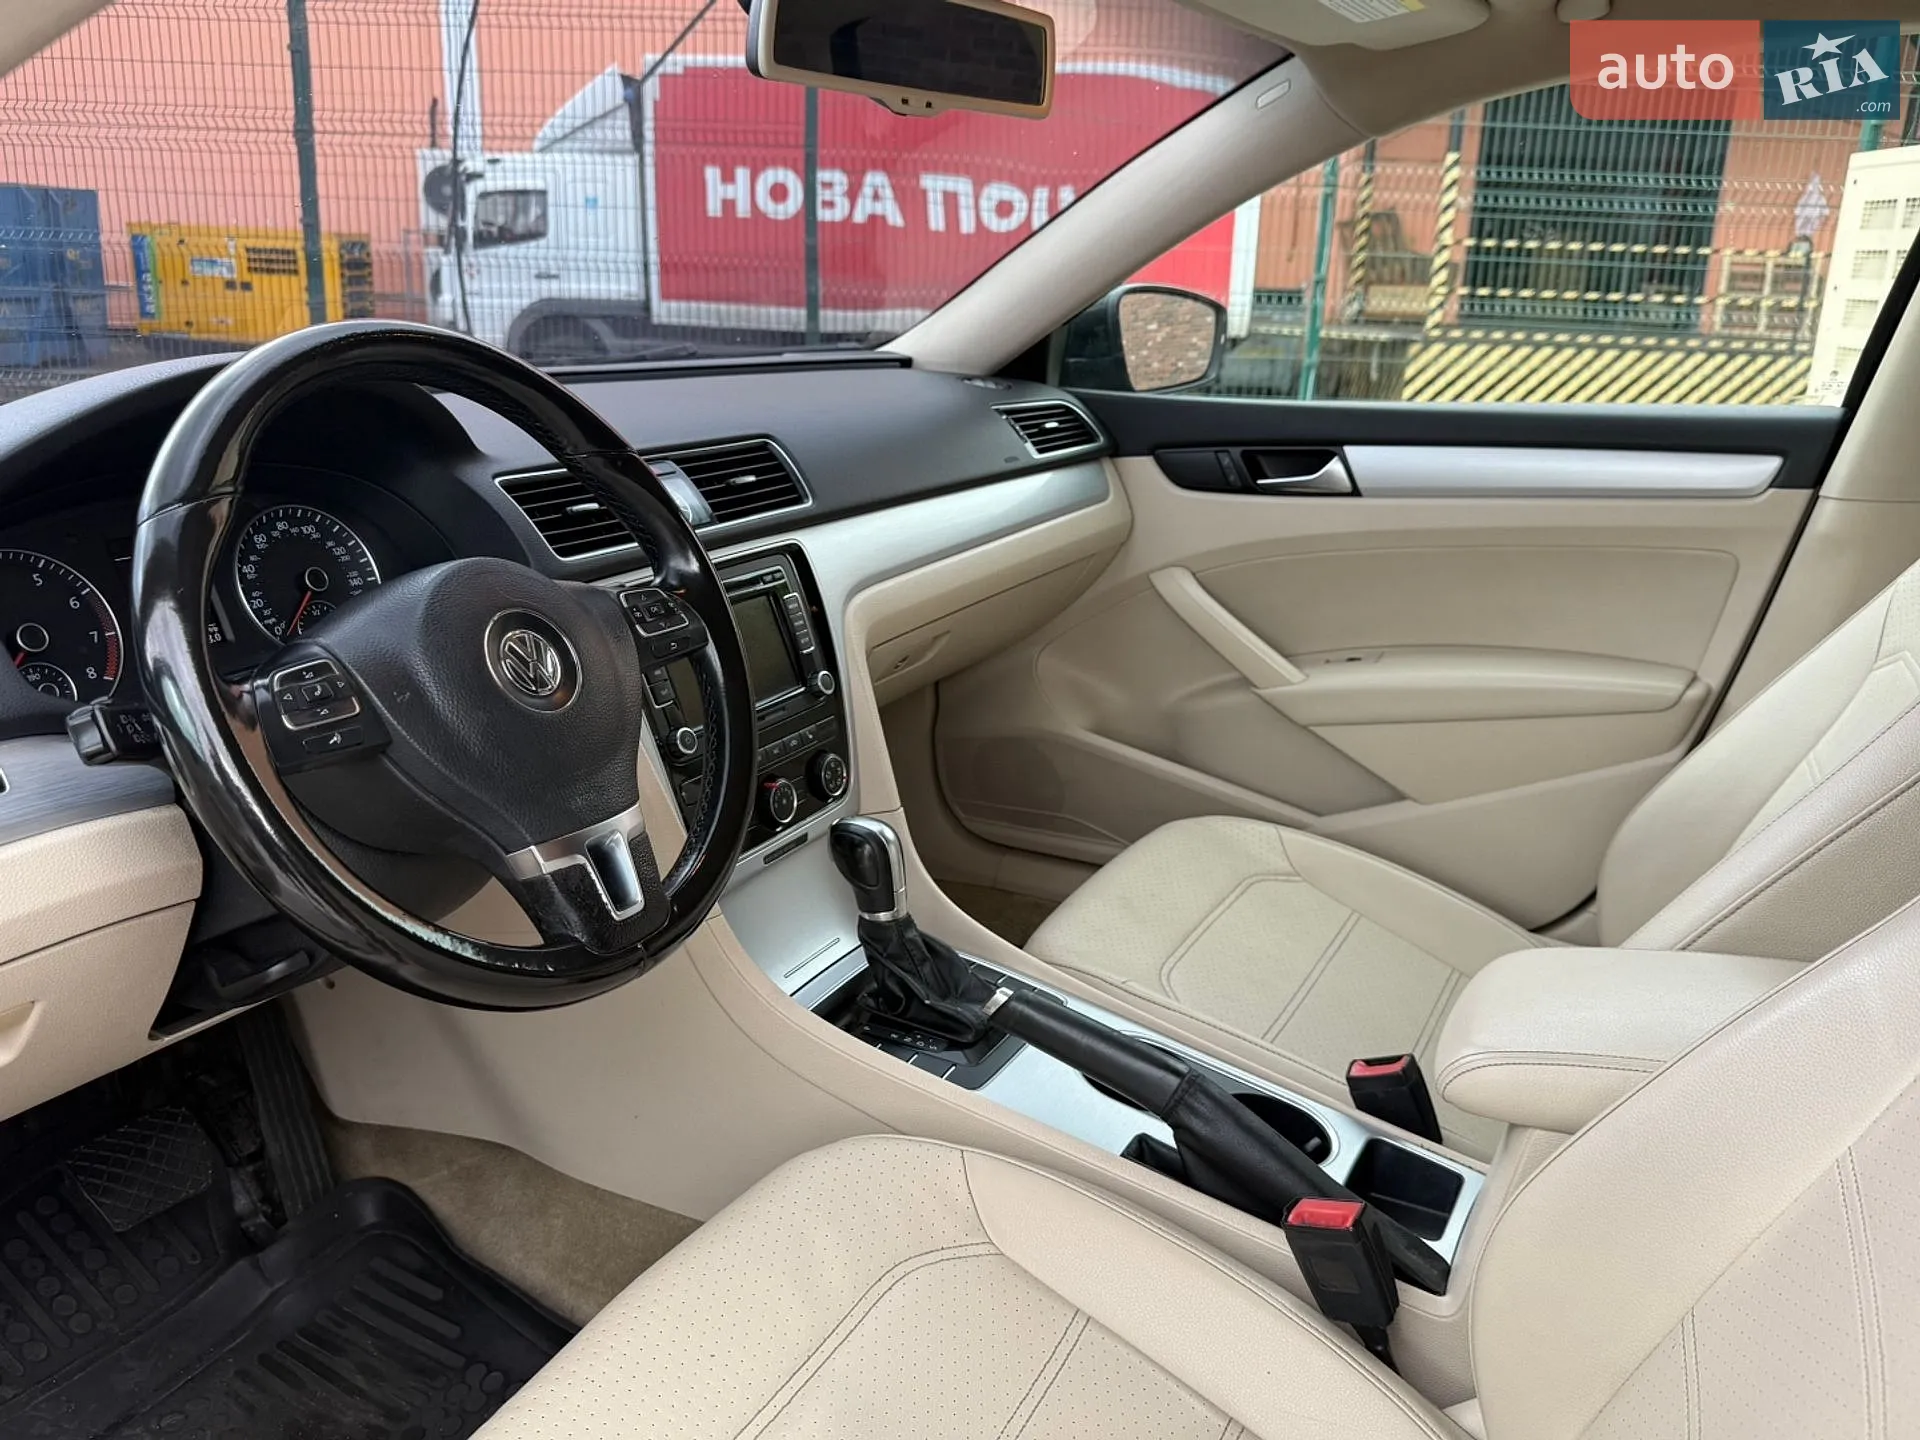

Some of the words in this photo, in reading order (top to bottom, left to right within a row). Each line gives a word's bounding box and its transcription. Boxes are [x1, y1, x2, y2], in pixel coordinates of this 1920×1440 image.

[704, 165, 905, 228] НОВА
[276, 521, 289, 531] 80
[301, 524, 316, 535] 100
[253, 533, 267, 544] 60
[242, 564, 255, 574] 40
[32, 573, 43, 587] 5
[69, 596, 80, 609] 6
[250, 599, 264, 609] 20
[274, 626, 282, 636] 0
[89, 630, 99, 644] 7
[86, 666, 97, 679] 8
